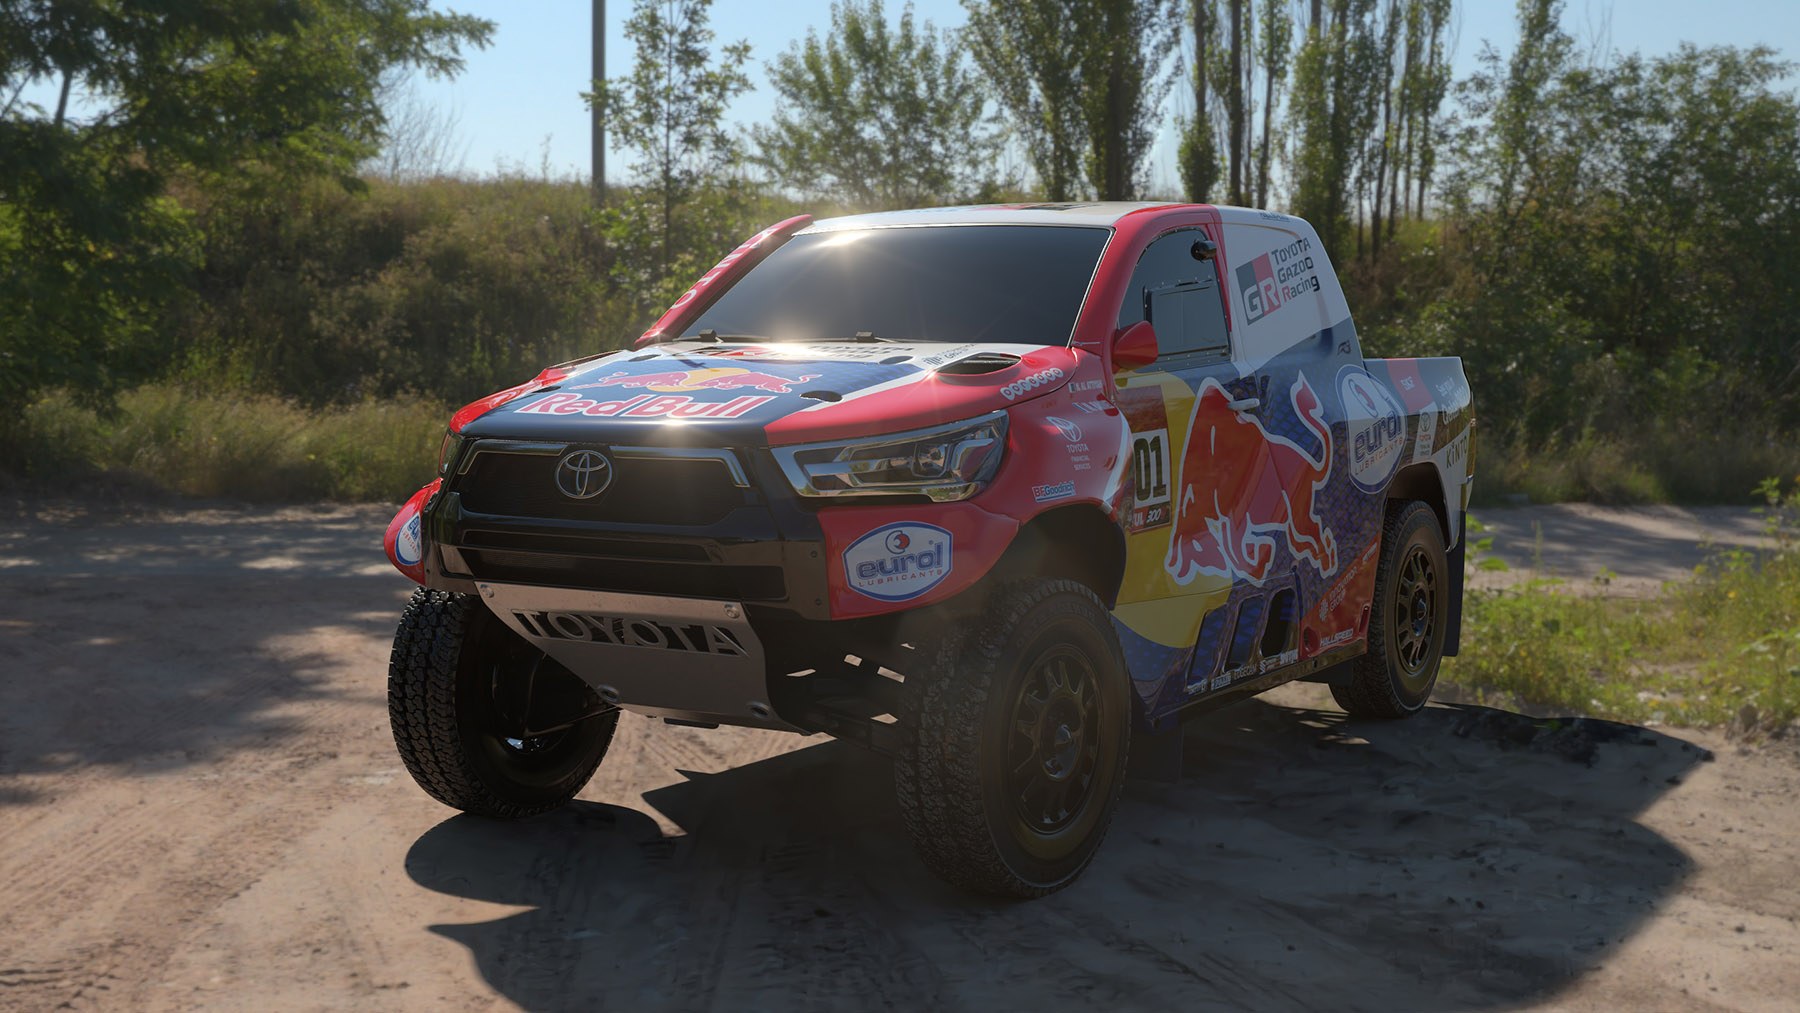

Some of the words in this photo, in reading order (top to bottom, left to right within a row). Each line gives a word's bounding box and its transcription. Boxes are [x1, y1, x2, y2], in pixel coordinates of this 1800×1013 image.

[1271, 237, 1311, 265] TOYOTA
[1277, 257, 1314, 284] GAZOO
[1244, 277, 1280, 316] GR
[1281, 275, 1320, 303] Racing
[514, 393, 656, 417] Red
[619, 396, 778, 418] Bull
[1066, 443, 1089, 453] TOYOTA
[1355, 410, 1402, 463] eurol
[1134, 436, 1167, 502] 01
[1355, 437, 1403, 475] LUBRICANTS
[1446, 437, 1467, 469] KINTO
[855, 545, 943, 580] eurol
[858, 569, 943, 587] LUBRICANTS
[513, 610, 749, 656] TOYOTA
